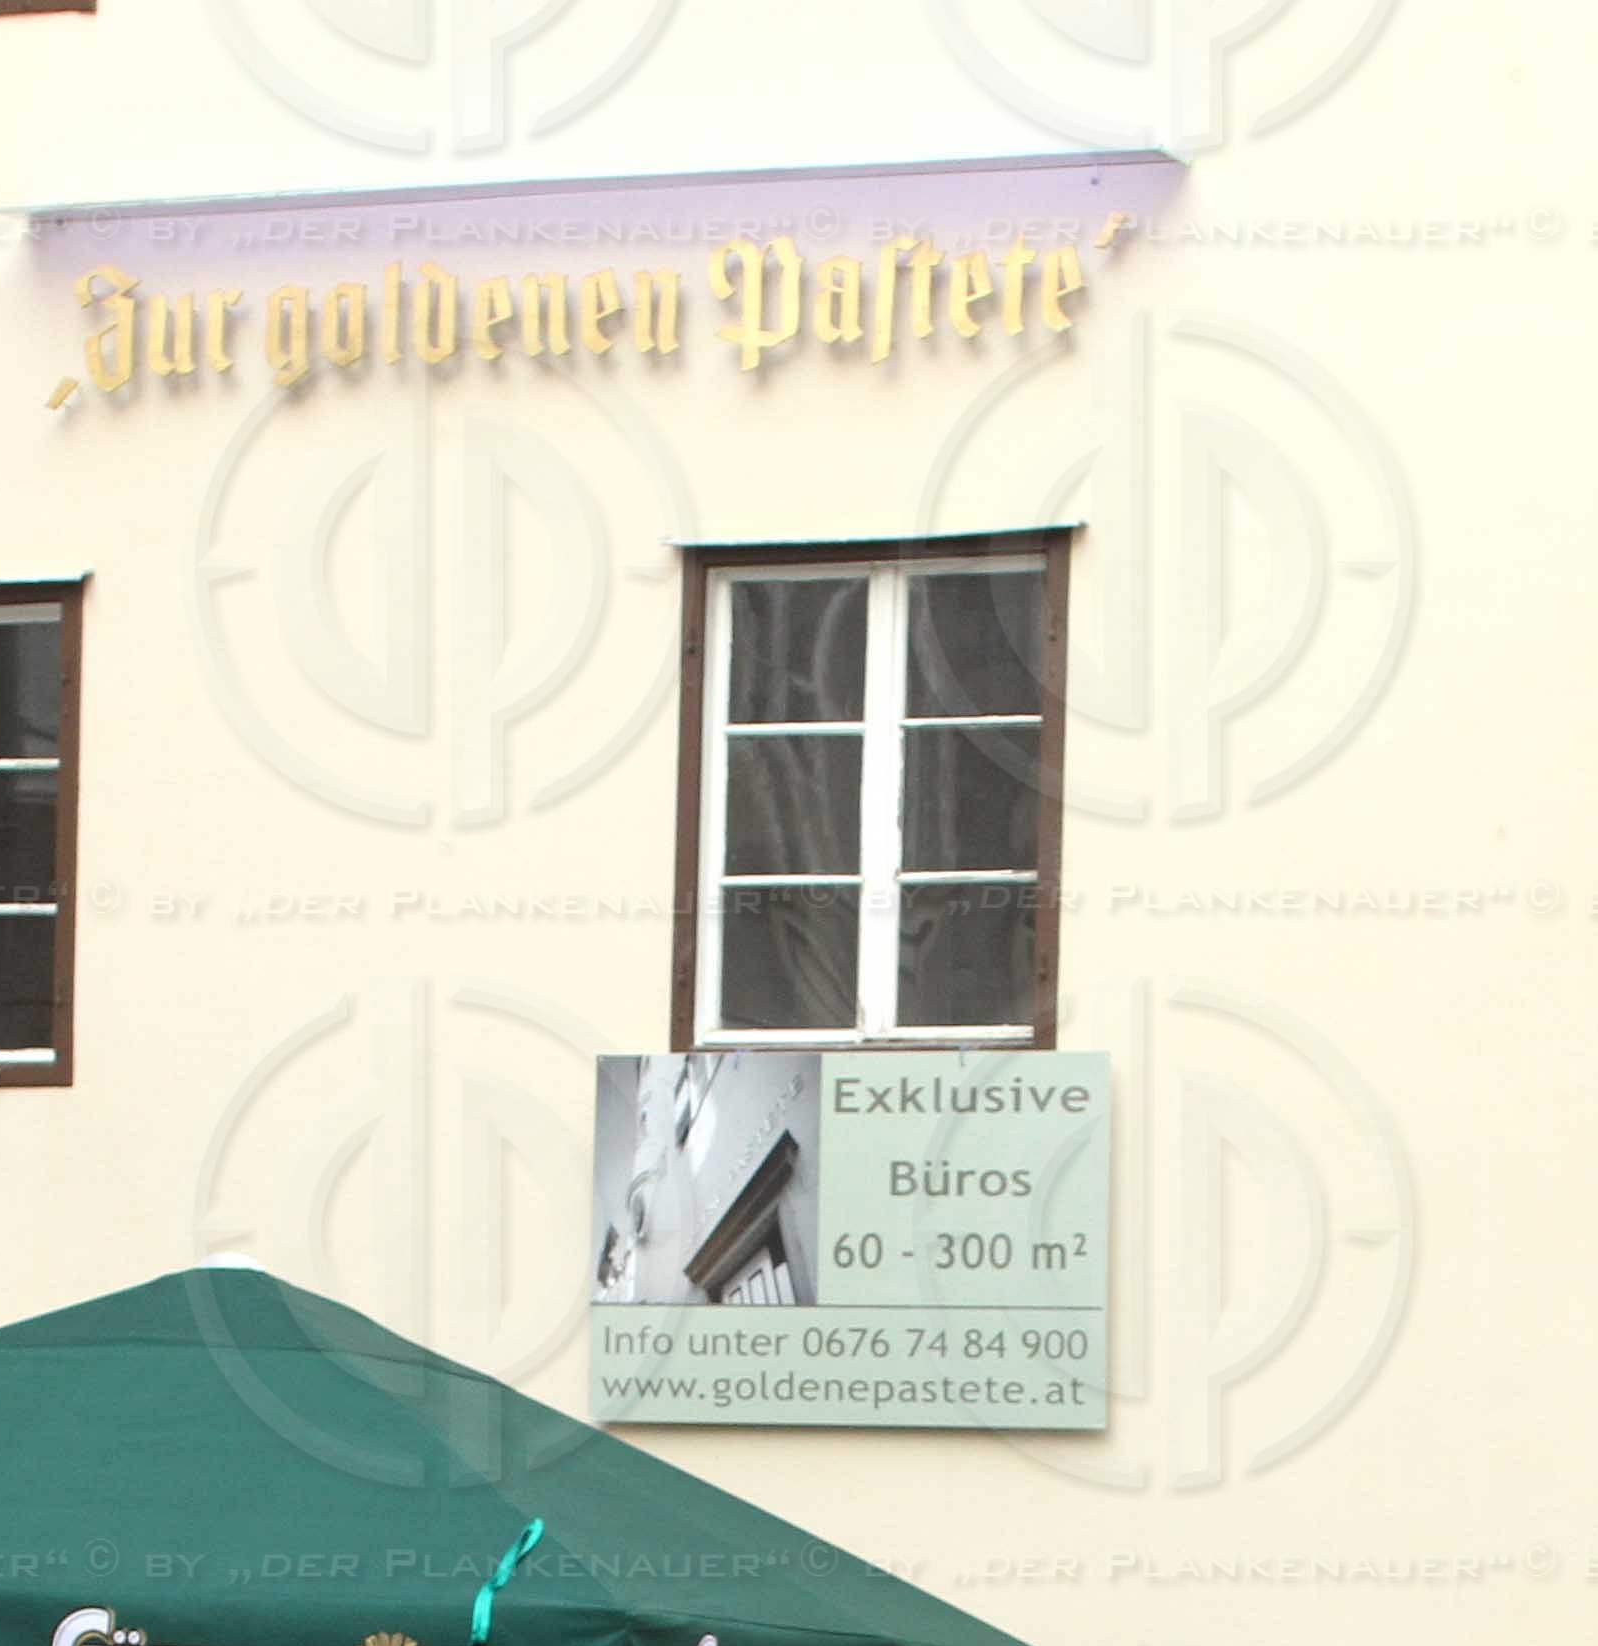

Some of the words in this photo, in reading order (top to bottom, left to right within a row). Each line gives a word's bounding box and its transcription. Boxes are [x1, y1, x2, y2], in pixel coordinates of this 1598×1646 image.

[265, 260, 681, 386] goldenen
[833, 1077, 1090, 1114] Exklusive
[889, 1160, 1032, 1198] Büros
[833, 1233, 884, 1270] 60
[935, 1233, 1013, 1270] 300
[1032, 1234, 1088, 1270] m²
[603, 1326, 673, 1357] Info
[688, 1330, 789, 1358] unter
[803, 1327, 891, 1358] 0676
[905, 1328, 949, 1358] 74
[963, 1329, 1007, 1359] 84
[1021, 1330, 1088, 1360] 900
[602, 1371, 1086, 1410] www.goldenepastete.at
